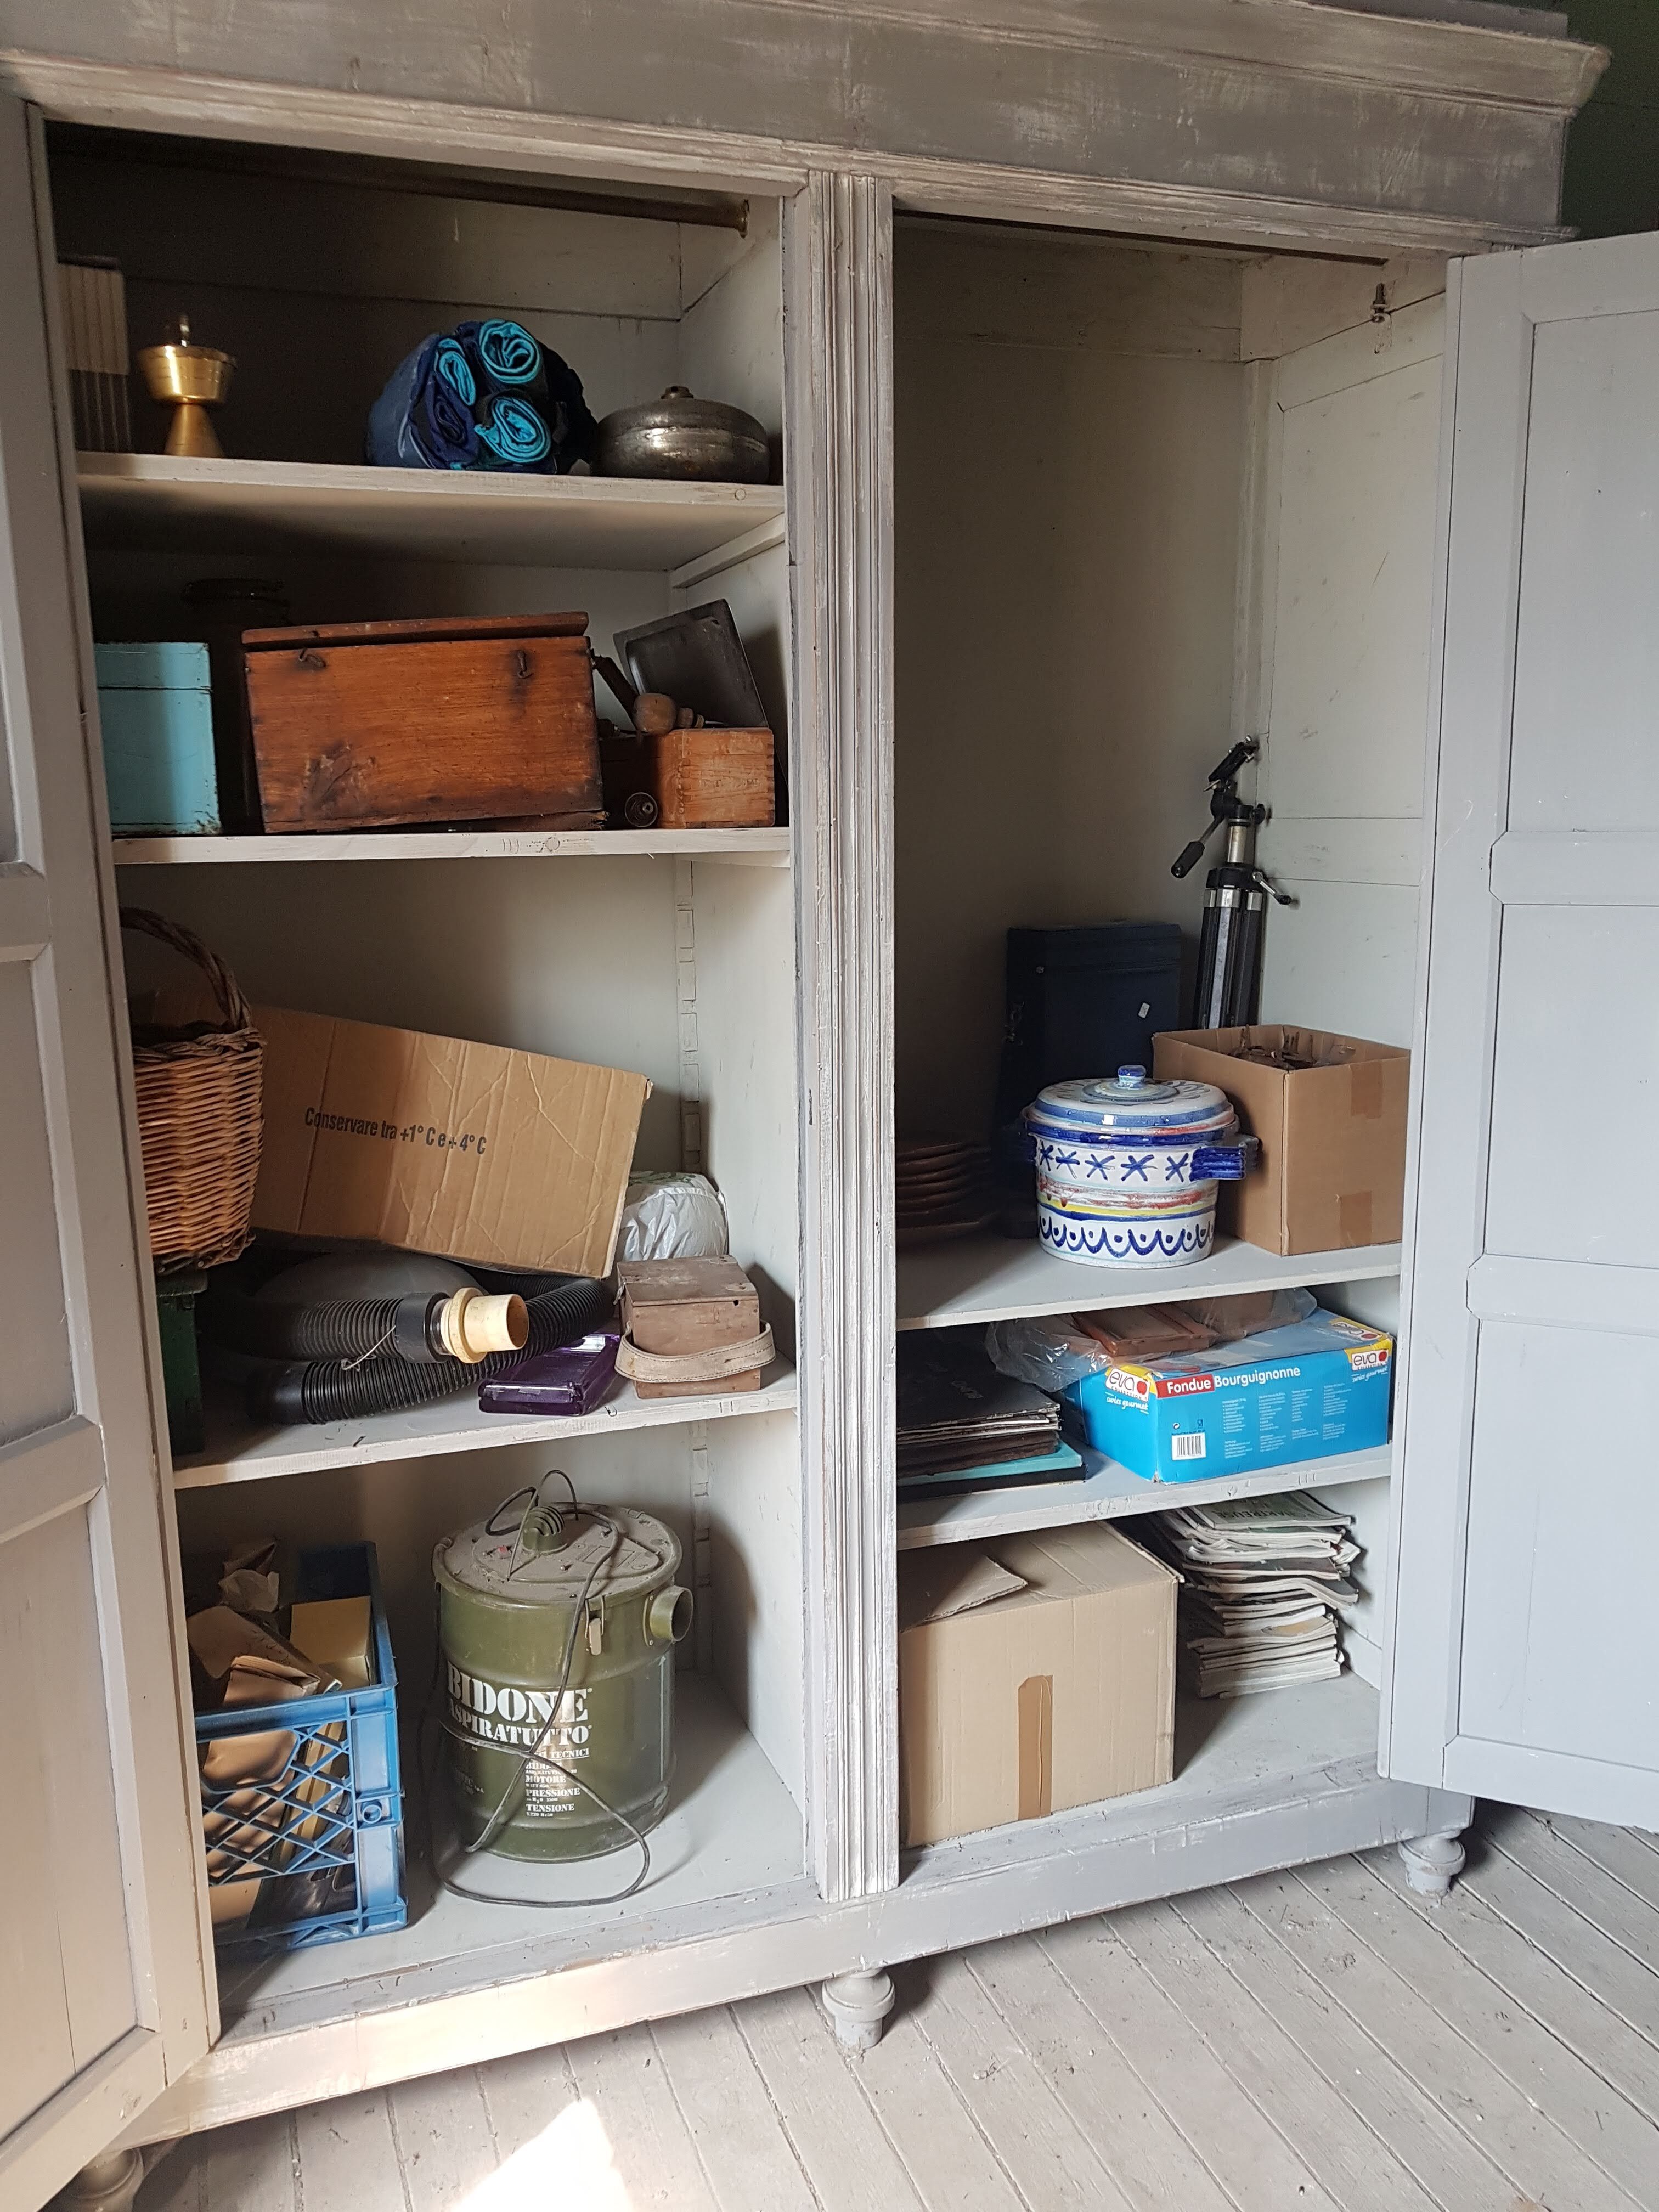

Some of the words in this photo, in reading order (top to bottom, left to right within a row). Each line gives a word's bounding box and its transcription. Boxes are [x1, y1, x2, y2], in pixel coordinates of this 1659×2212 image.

[304, 1107, 377, 1136] Conservare
[381, 1120, 397, 1139] tra
[1353, 1353, 1377, 1366] eva
[1109, 1372, 1135, 1391] eva
[1167, 1378, 1211, 1394] Fondue
[1215, 1367, 1301, 1388] Bourguignonne
[1122, 1400, 1149, 1410] gourmet
[447, 1660, 589, 1723] BIDONE
[449, 1698, 589, 1747] ASPIRATUTTO
[550, 1748, 590, 1759] TECNICI
[525, 1775, 567, 1784] MOTORE
[526, 1788, 580, 1797] PRESSIONE
[526, 1803, 575, 1812] TENSIONE
